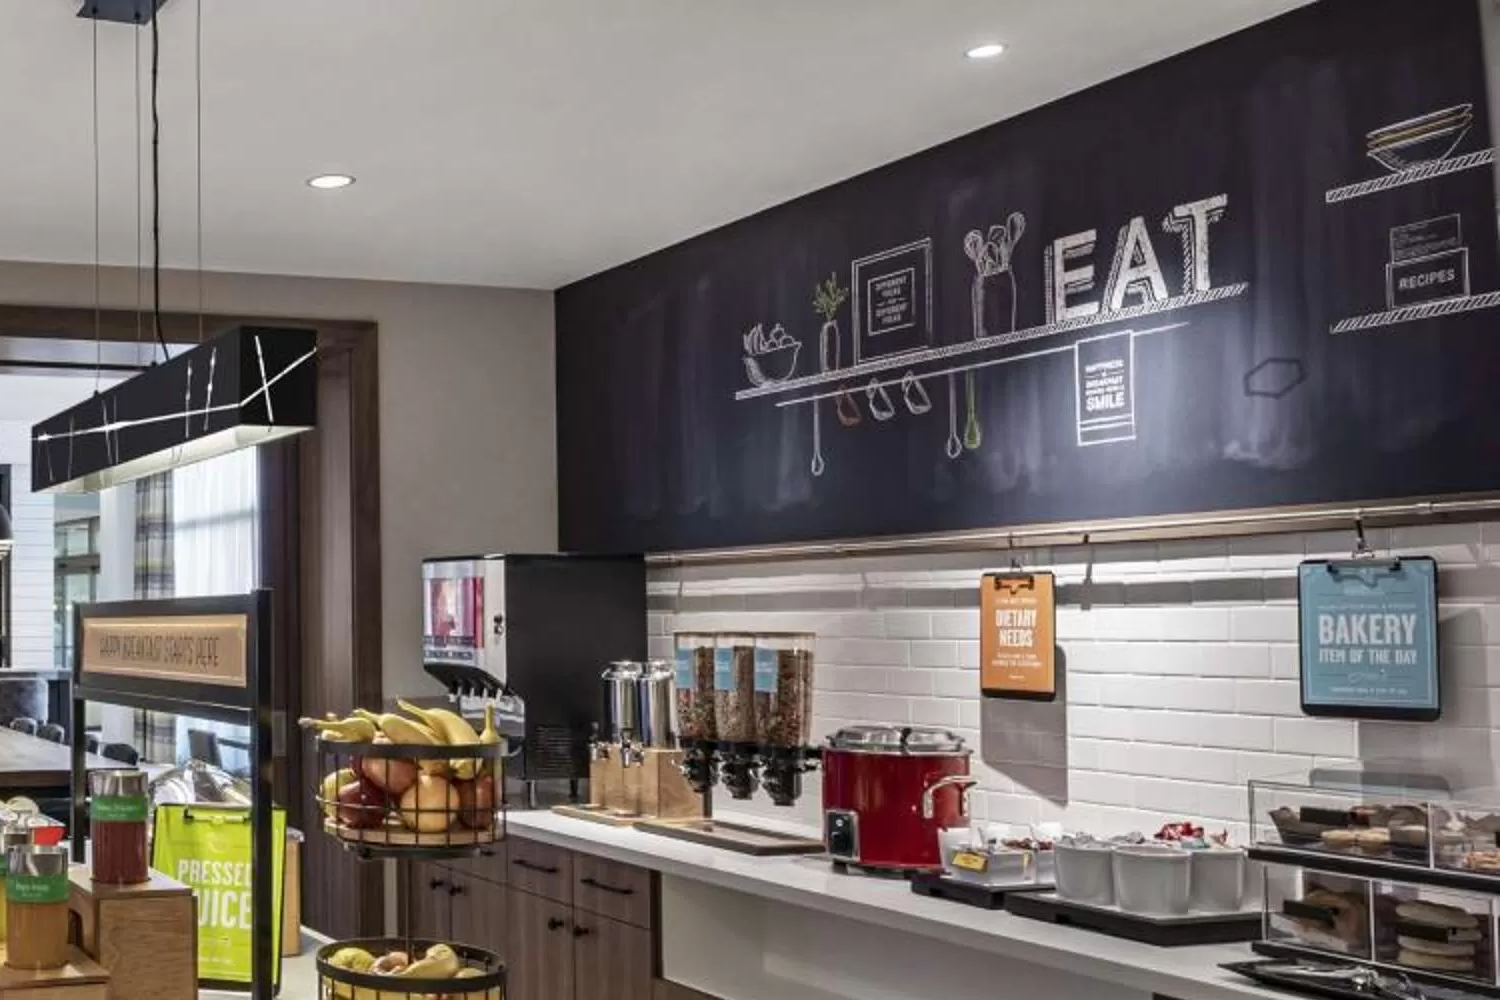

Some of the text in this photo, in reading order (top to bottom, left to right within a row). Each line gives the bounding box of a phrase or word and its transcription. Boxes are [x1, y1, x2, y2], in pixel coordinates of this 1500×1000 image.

[1045, 193, 1229, 324] EAT
[1398, 267, 1456, 291] RECIPES
[1086, 391, 1125, 412] SMILE
[995, 608, 1037, 628] DIETARY
[1319, 612, 1418, 646] BAKERY
[999, 628, 1034, 647] NEEDS
[1319, 648, 1417, 665] ITEM OF THE DAY
[192, 887, 252, 930] UICE
